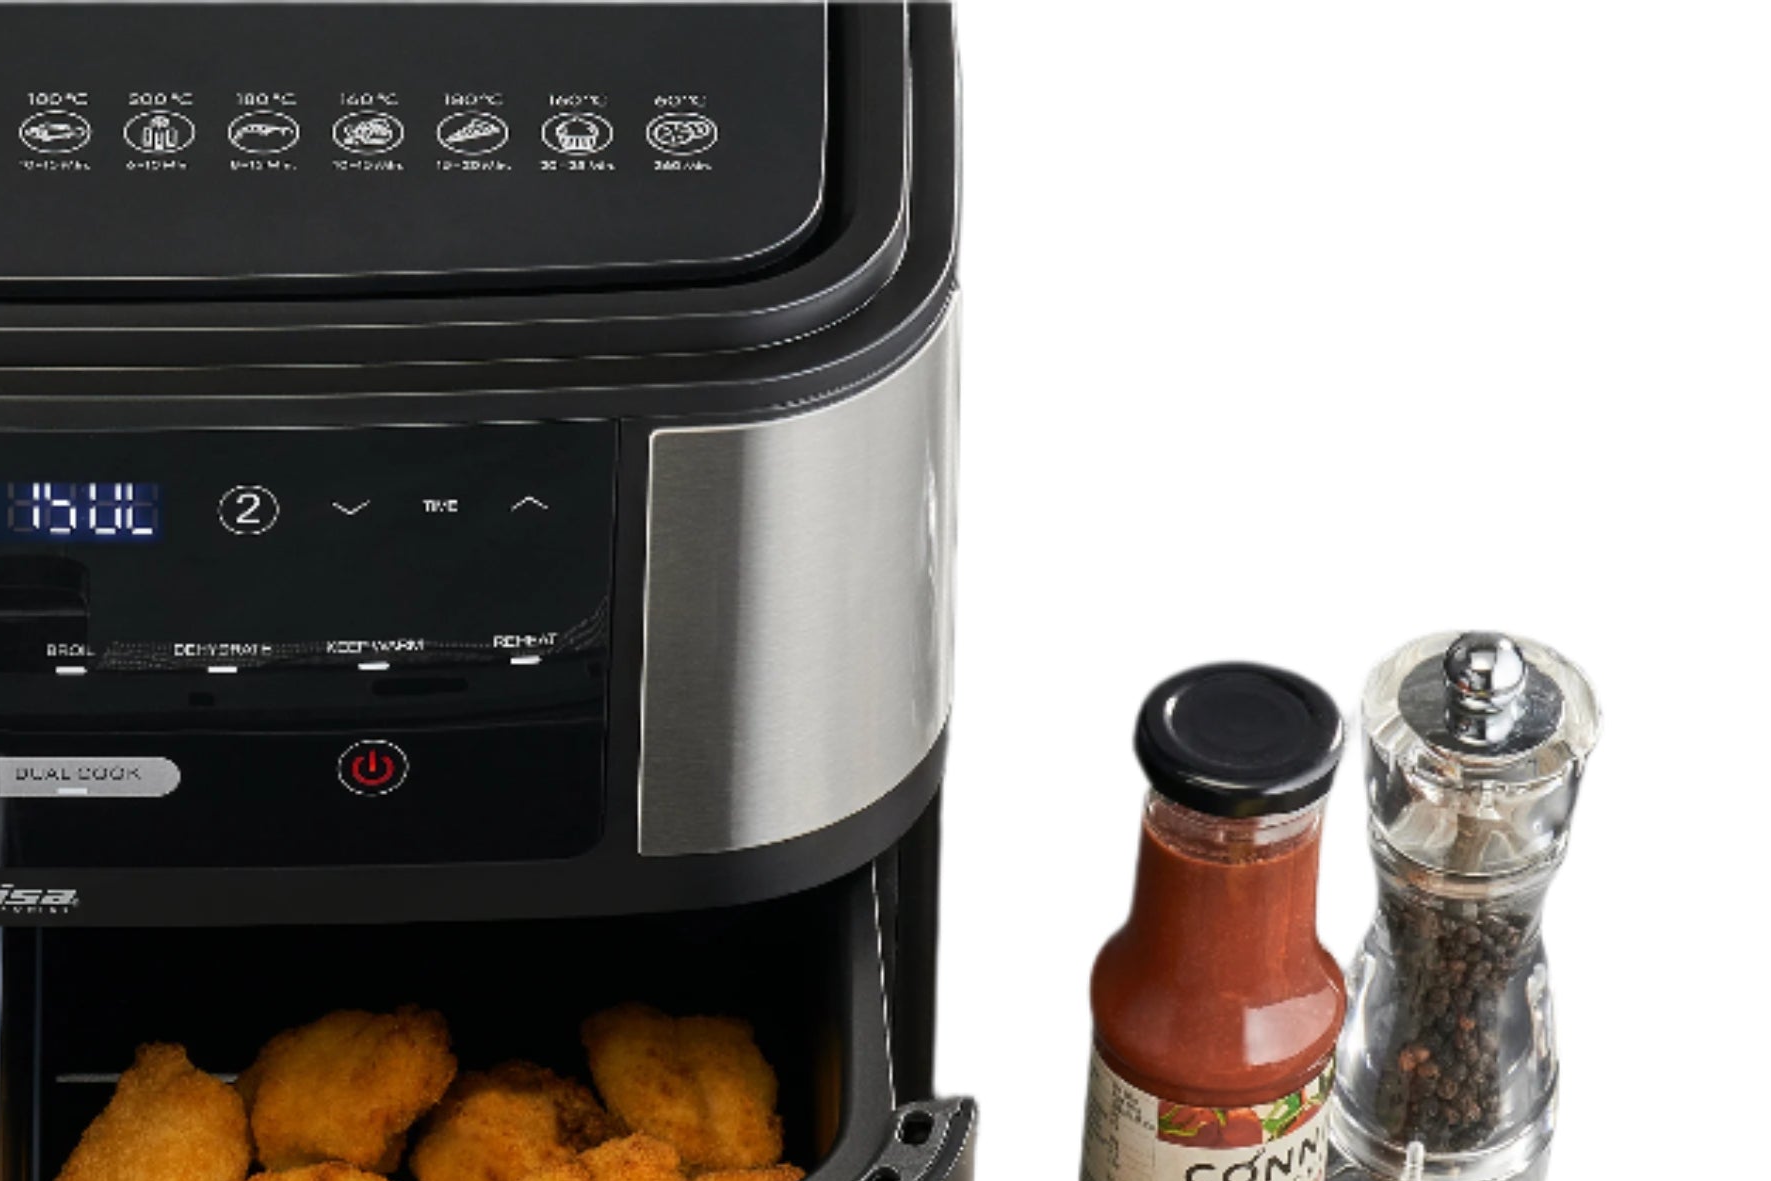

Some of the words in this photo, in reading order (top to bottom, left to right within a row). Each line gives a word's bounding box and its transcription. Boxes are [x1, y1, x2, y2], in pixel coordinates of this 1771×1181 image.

[235, 493, 261, 523] 2
[422, 499, 459, 512] TIME
[493, 632, 558, 648] REHEAT
[46, 643, 96, 656] BROIL
[173, 643, 273, 656] DEHYDRATE
[15, 766, 71, 781] DUAL
[78, 766, 141, 781] COOK
